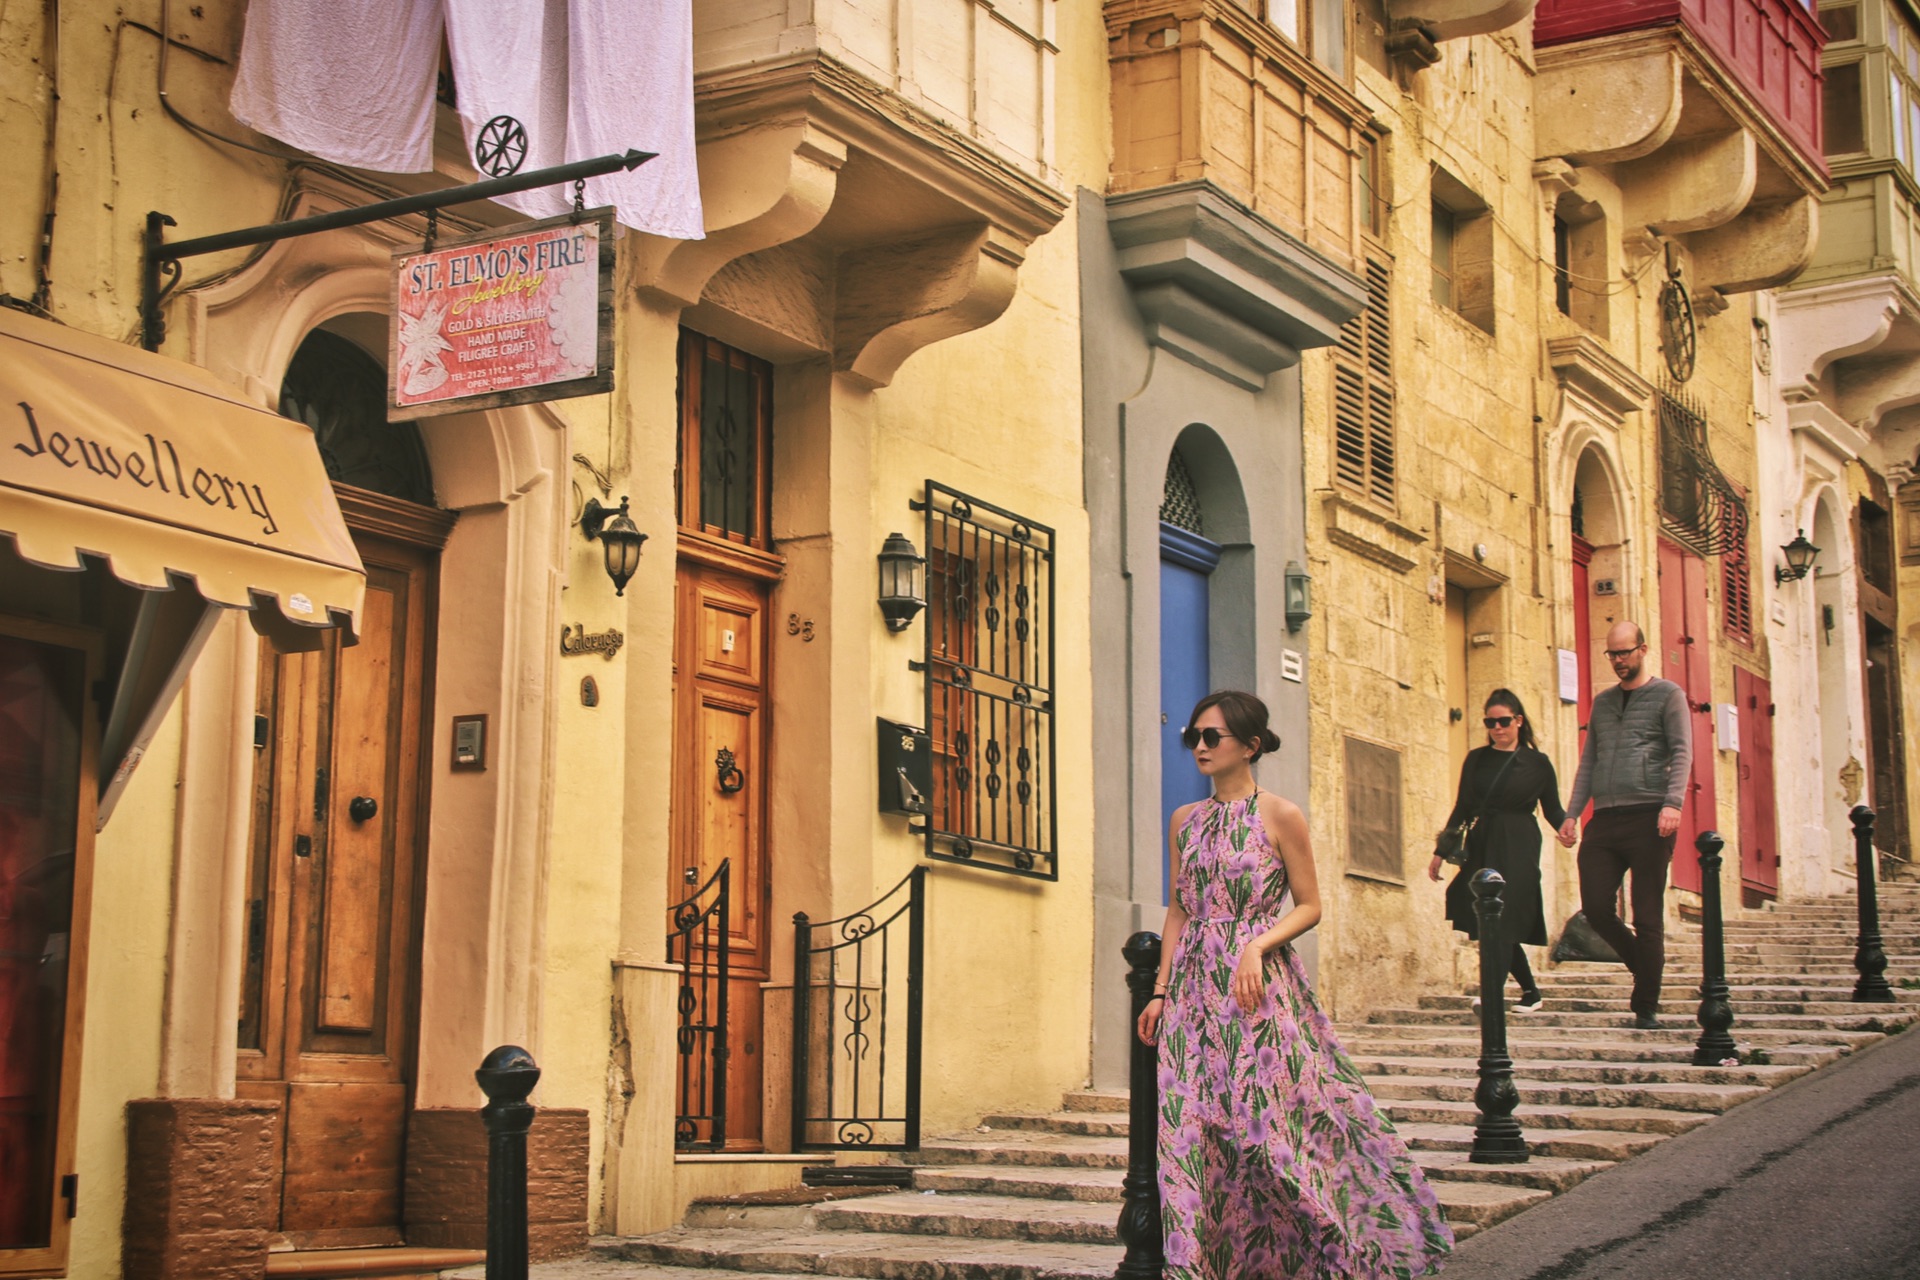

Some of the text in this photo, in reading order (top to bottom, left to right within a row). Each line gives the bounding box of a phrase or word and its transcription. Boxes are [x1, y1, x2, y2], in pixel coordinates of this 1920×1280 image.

[411, 234, 586, 294] ST. ELMO'S FIRE
[451, 269, 546, 316] Jewellery
[447, 307, 546, 334] GOLD & SILVERSMITH
[458, 340, 537, 362] FILIGREE CRAFTS
[467, 327, 527, 348] HAND MADE
[467, 369, 487, 380] 2125
[13, 401, 280, 535] Jewellery
